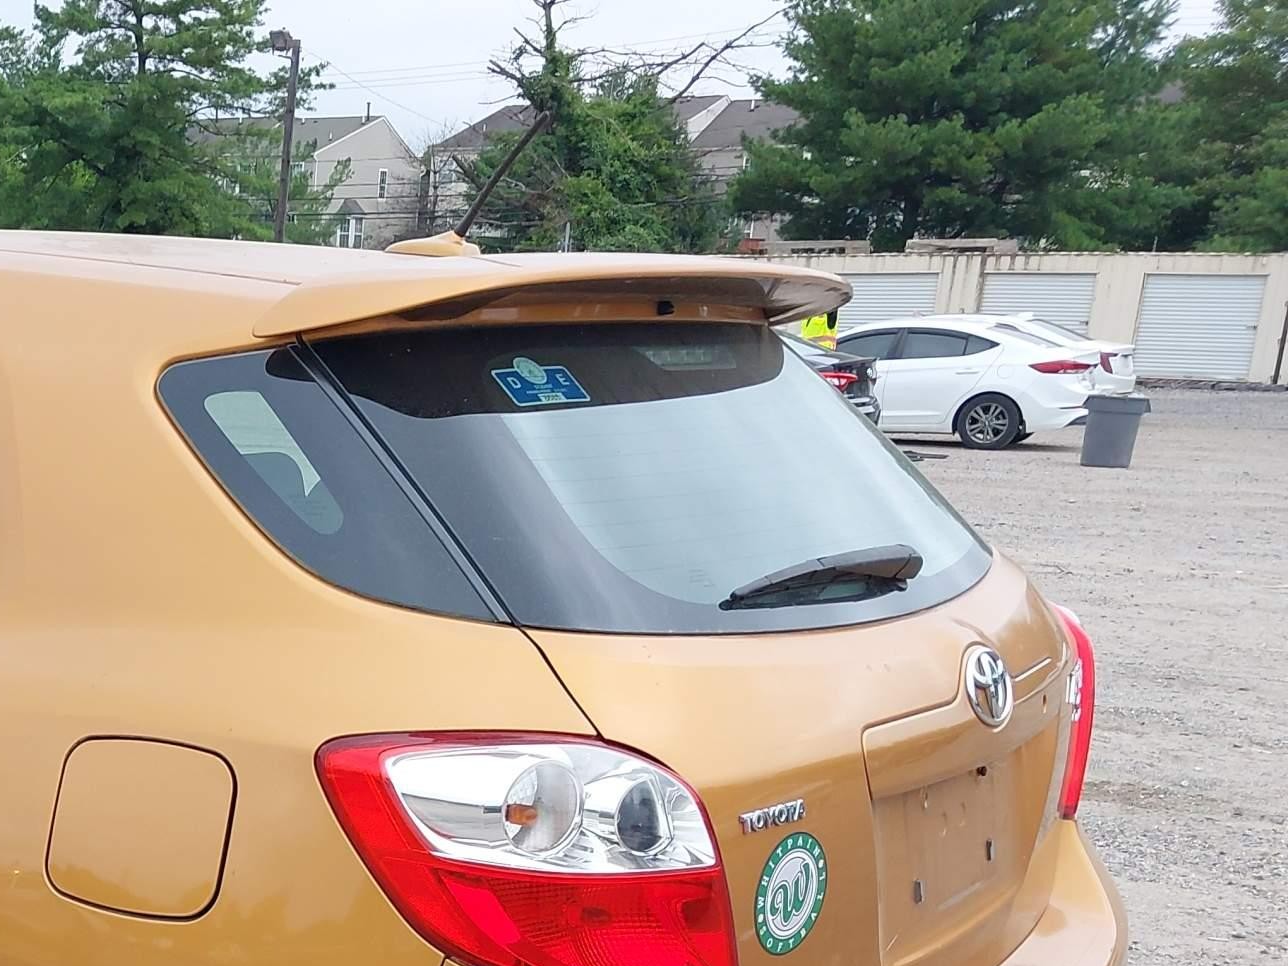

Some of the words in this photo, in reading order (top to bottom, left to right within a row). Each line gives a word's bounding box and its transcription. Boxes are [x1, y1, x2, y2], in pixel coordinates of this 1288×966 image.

[507, 377, 521, 388] D
[555, 373, 570, 385] E
[739, 799, 806, 834] TOYOTA
[757, 836, 821, 909] WHITPAIN
